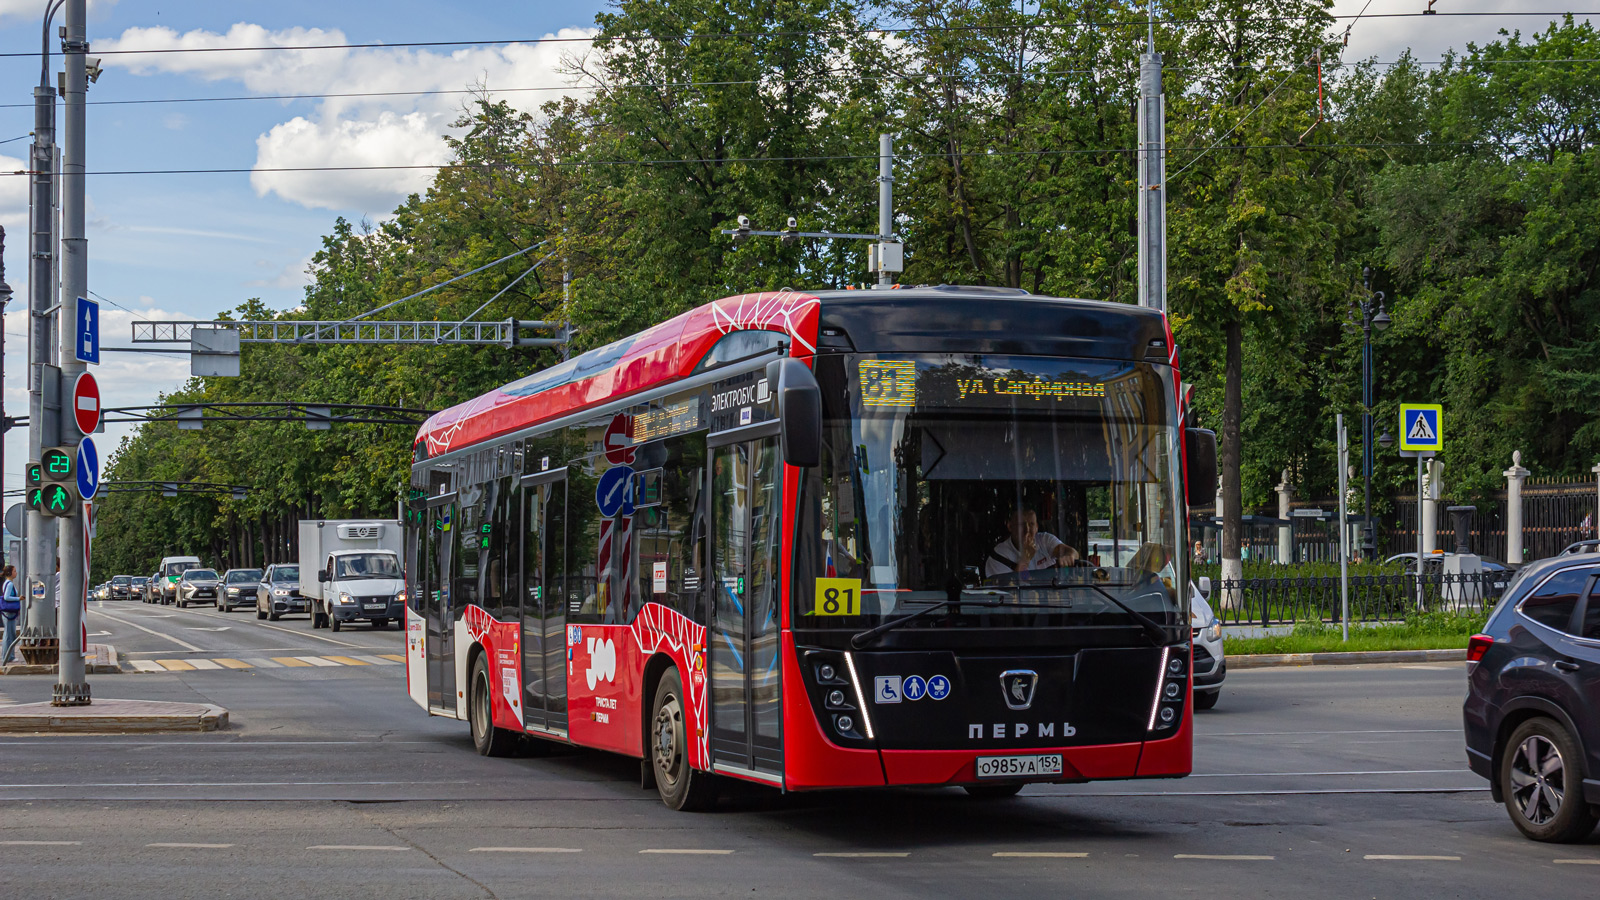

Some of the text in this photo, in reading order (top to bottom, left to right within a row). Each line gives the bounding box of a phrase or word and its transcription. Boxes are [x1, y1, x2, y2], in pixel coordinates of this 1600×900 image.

[711, 384, 756, 412] ЭЛЕКТРОБУС
[956, 376, 1105, 401] ул. Сапфирная
[49, 455, 70, 473] 23
[823, 587, 853, 614] 81
[585, 637, 617, 691] 300
[968, 722, 1077, 739] ПЕРМЬ
[1038, 756, 1058, 768] 159
